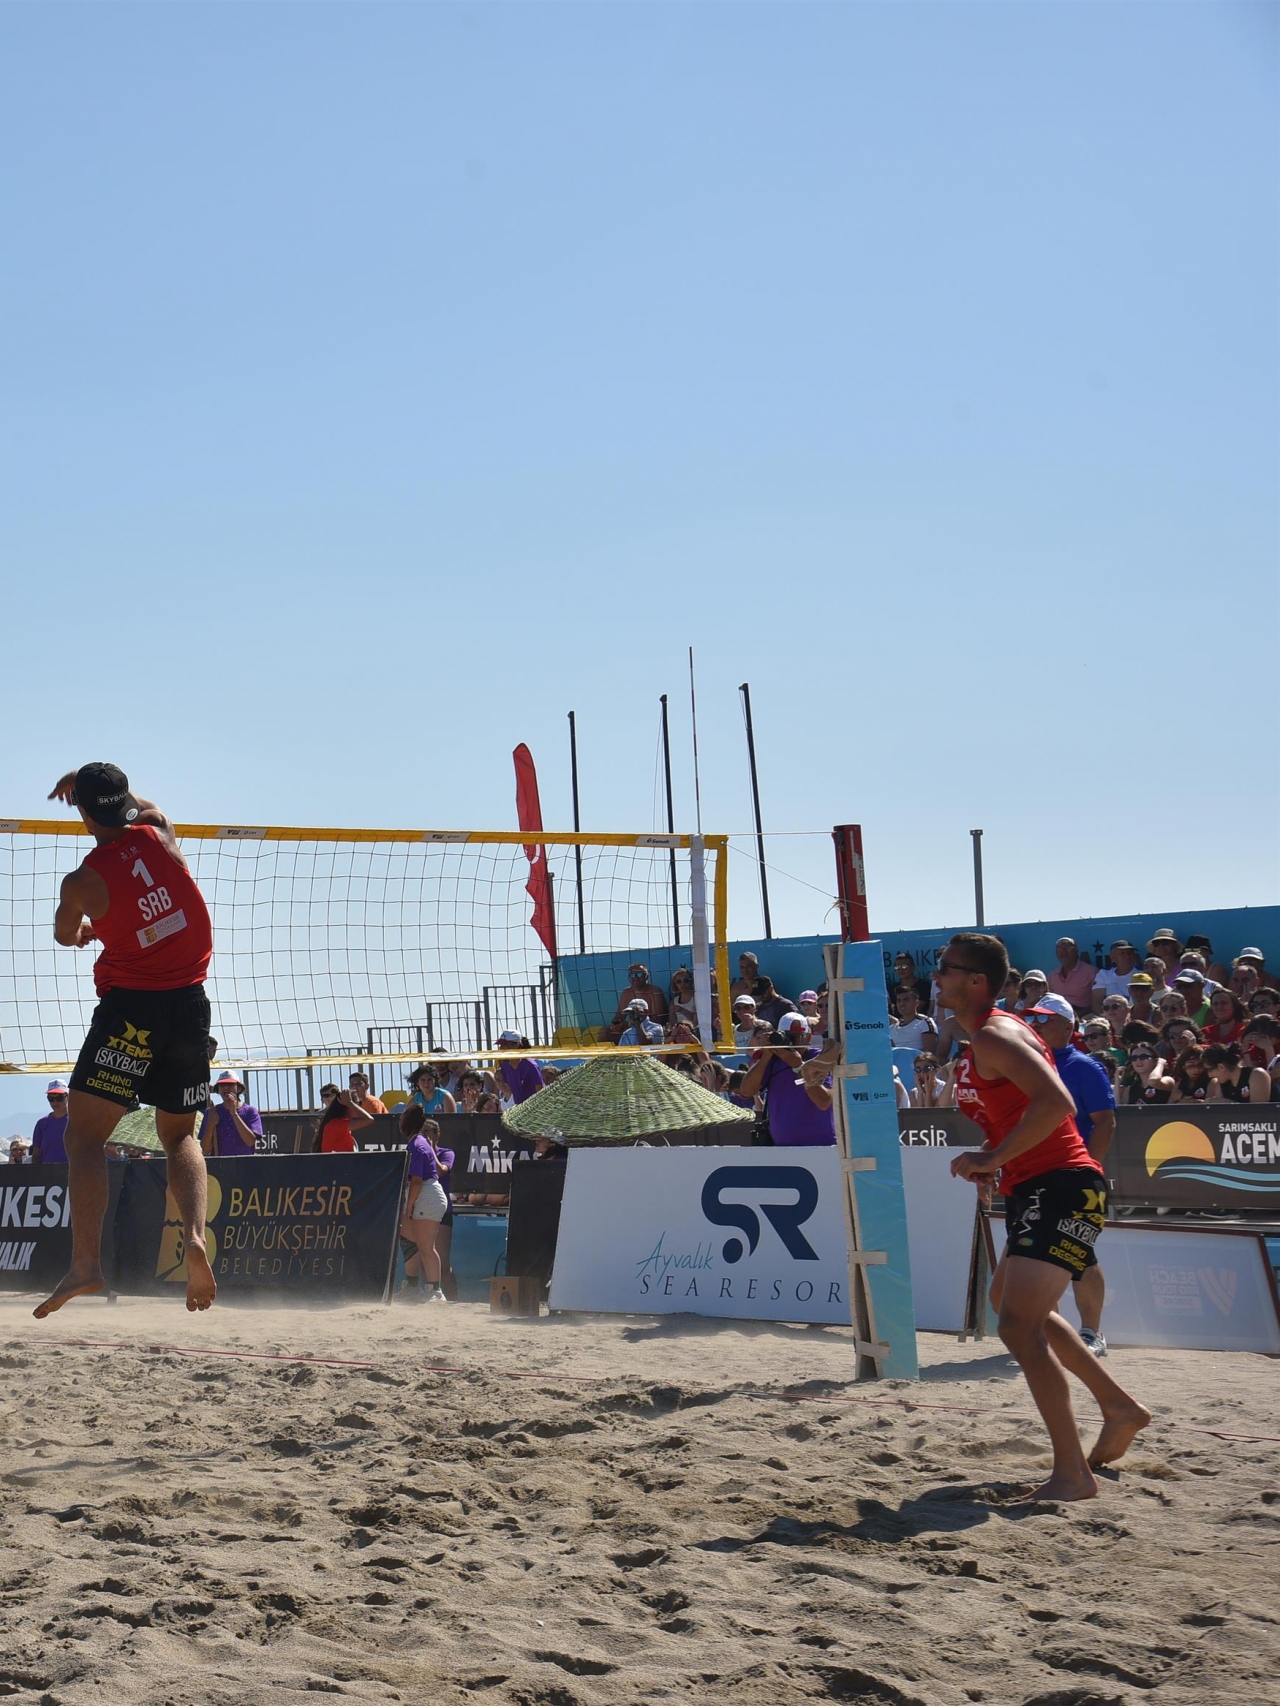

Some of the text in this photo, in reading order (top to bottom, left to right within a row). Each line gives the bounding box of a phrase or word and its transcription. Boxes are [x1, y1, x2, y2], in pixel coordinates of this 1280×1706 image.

[131, 857, 155, 888] 1
[137, 886, 173, 922] SRB
[853, 1021, 884, 1030] Senoh
[86, 1077, 135, 1098] DESIGNS
[97, 1070, 132, 1087] RHINO
[1218, 1123, 1277, 1132] SARIMSAKLI
[228, 1179, 353, 1217] BALIKESİR
[223, 1221, 347, 1256] BÜYÜKŞEHİR
[219, 1257, 344, 1276] BELEDİYESİ
[636, 1230, 714, 1287] Ayvalık
[639, 1274, 843, 1303] SEA RESOR
